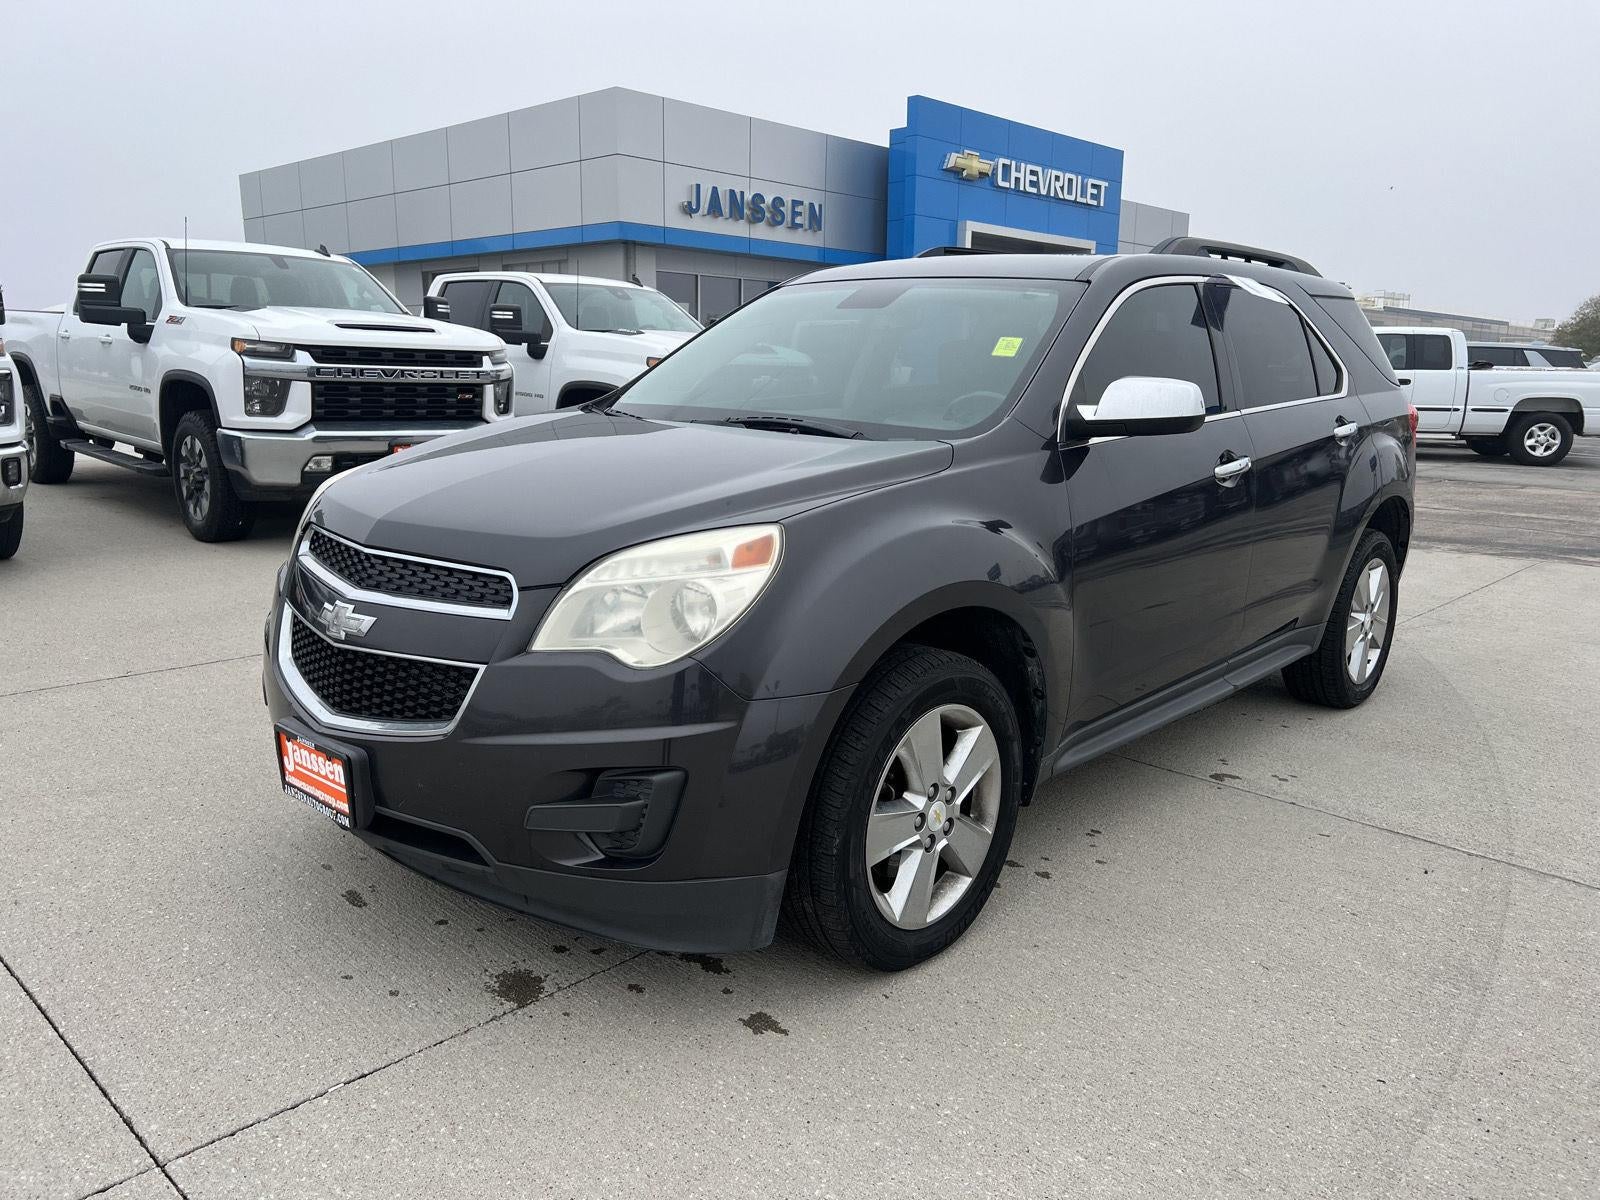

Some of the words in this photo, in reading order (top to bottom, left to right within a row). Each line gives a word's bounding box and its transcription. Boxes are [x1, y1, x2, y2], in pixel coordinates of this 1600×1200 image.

[995, 157, 1109, 207] CHEVROLET
[682, 182, 824, 232] JANSSEN
[315, 368, 485, 380] CHEVROLET
[284, 740, 345, 785] Janssen
